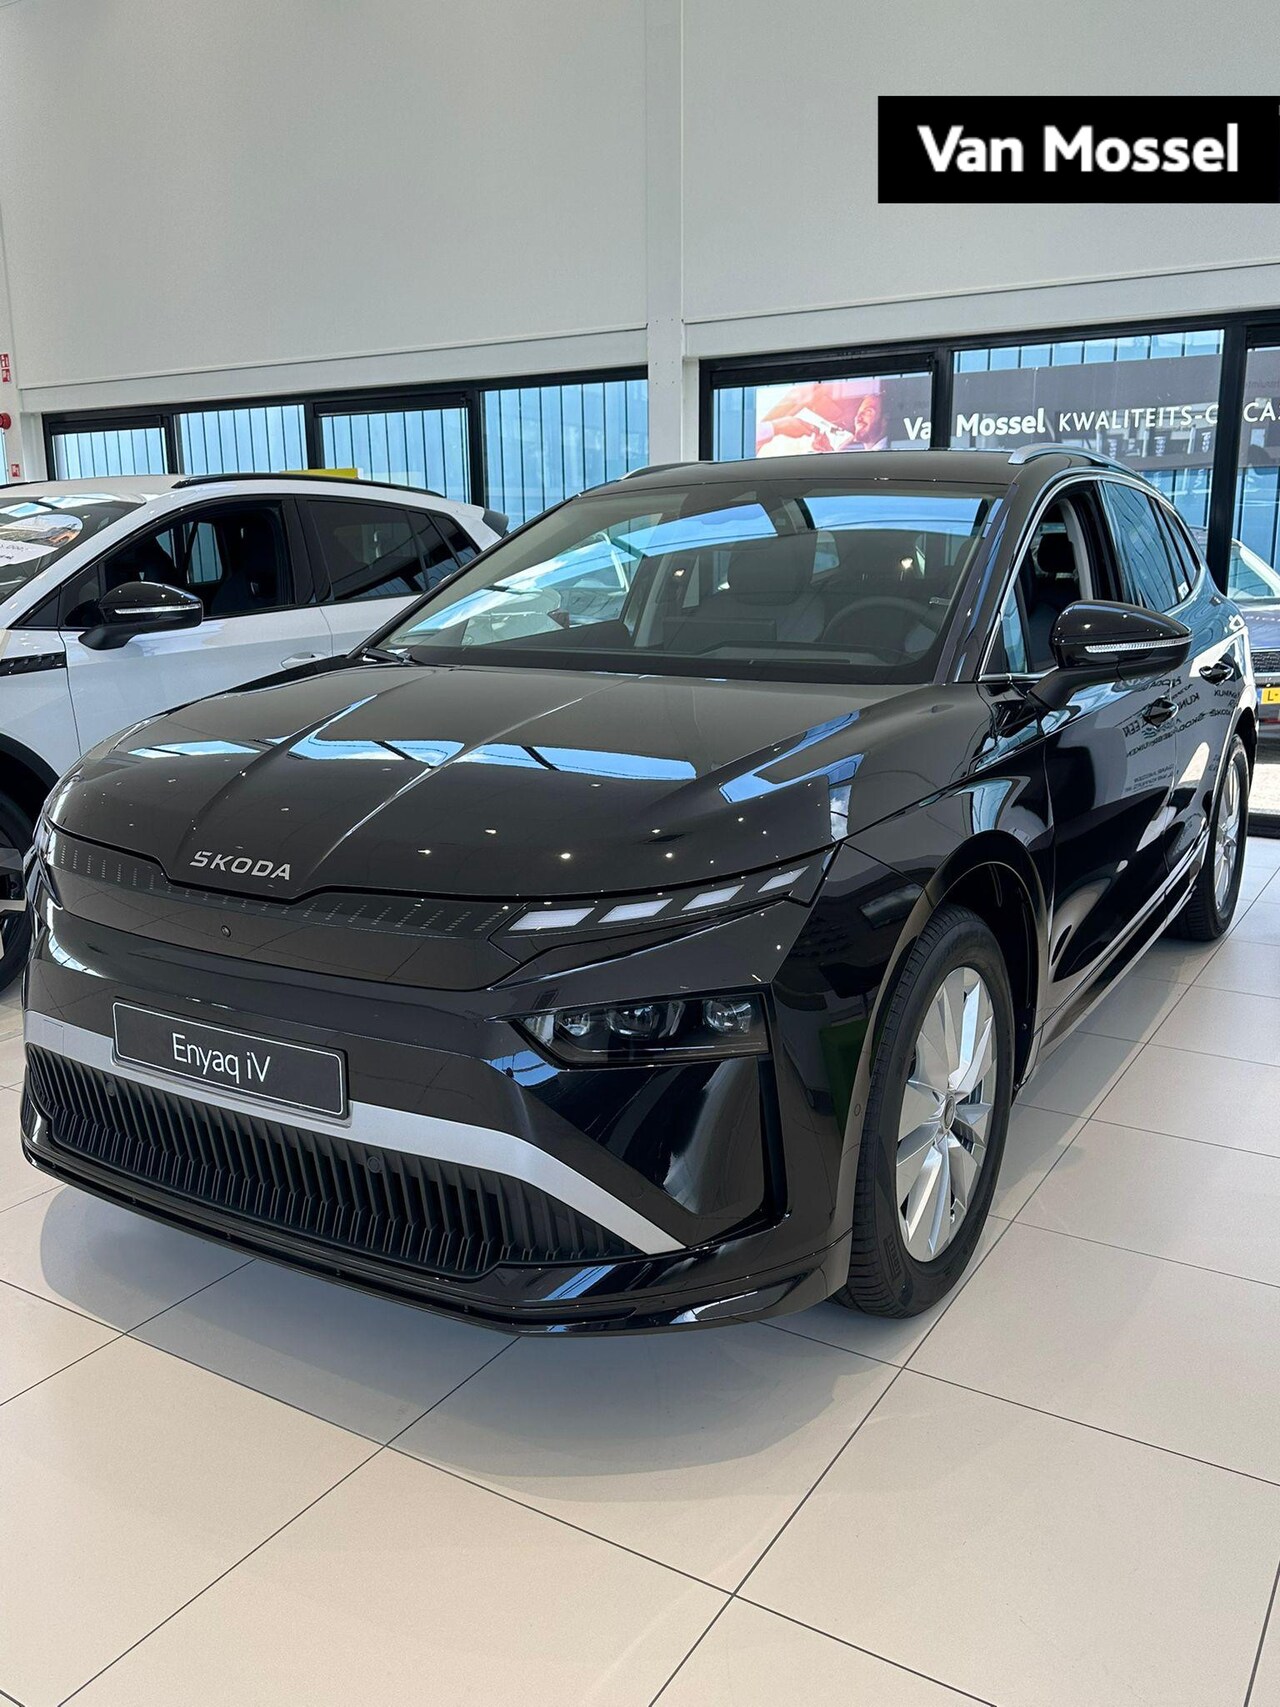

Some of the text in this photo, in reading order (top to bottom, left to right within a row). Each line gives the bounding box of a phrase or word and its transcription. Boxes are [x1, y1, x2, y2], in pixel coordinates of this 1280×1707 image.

[903, 416, 932, 440] Va
[956, 407, 1046, 438] Mossel
[171, 1032, 271, 1084] Enyaq iV
